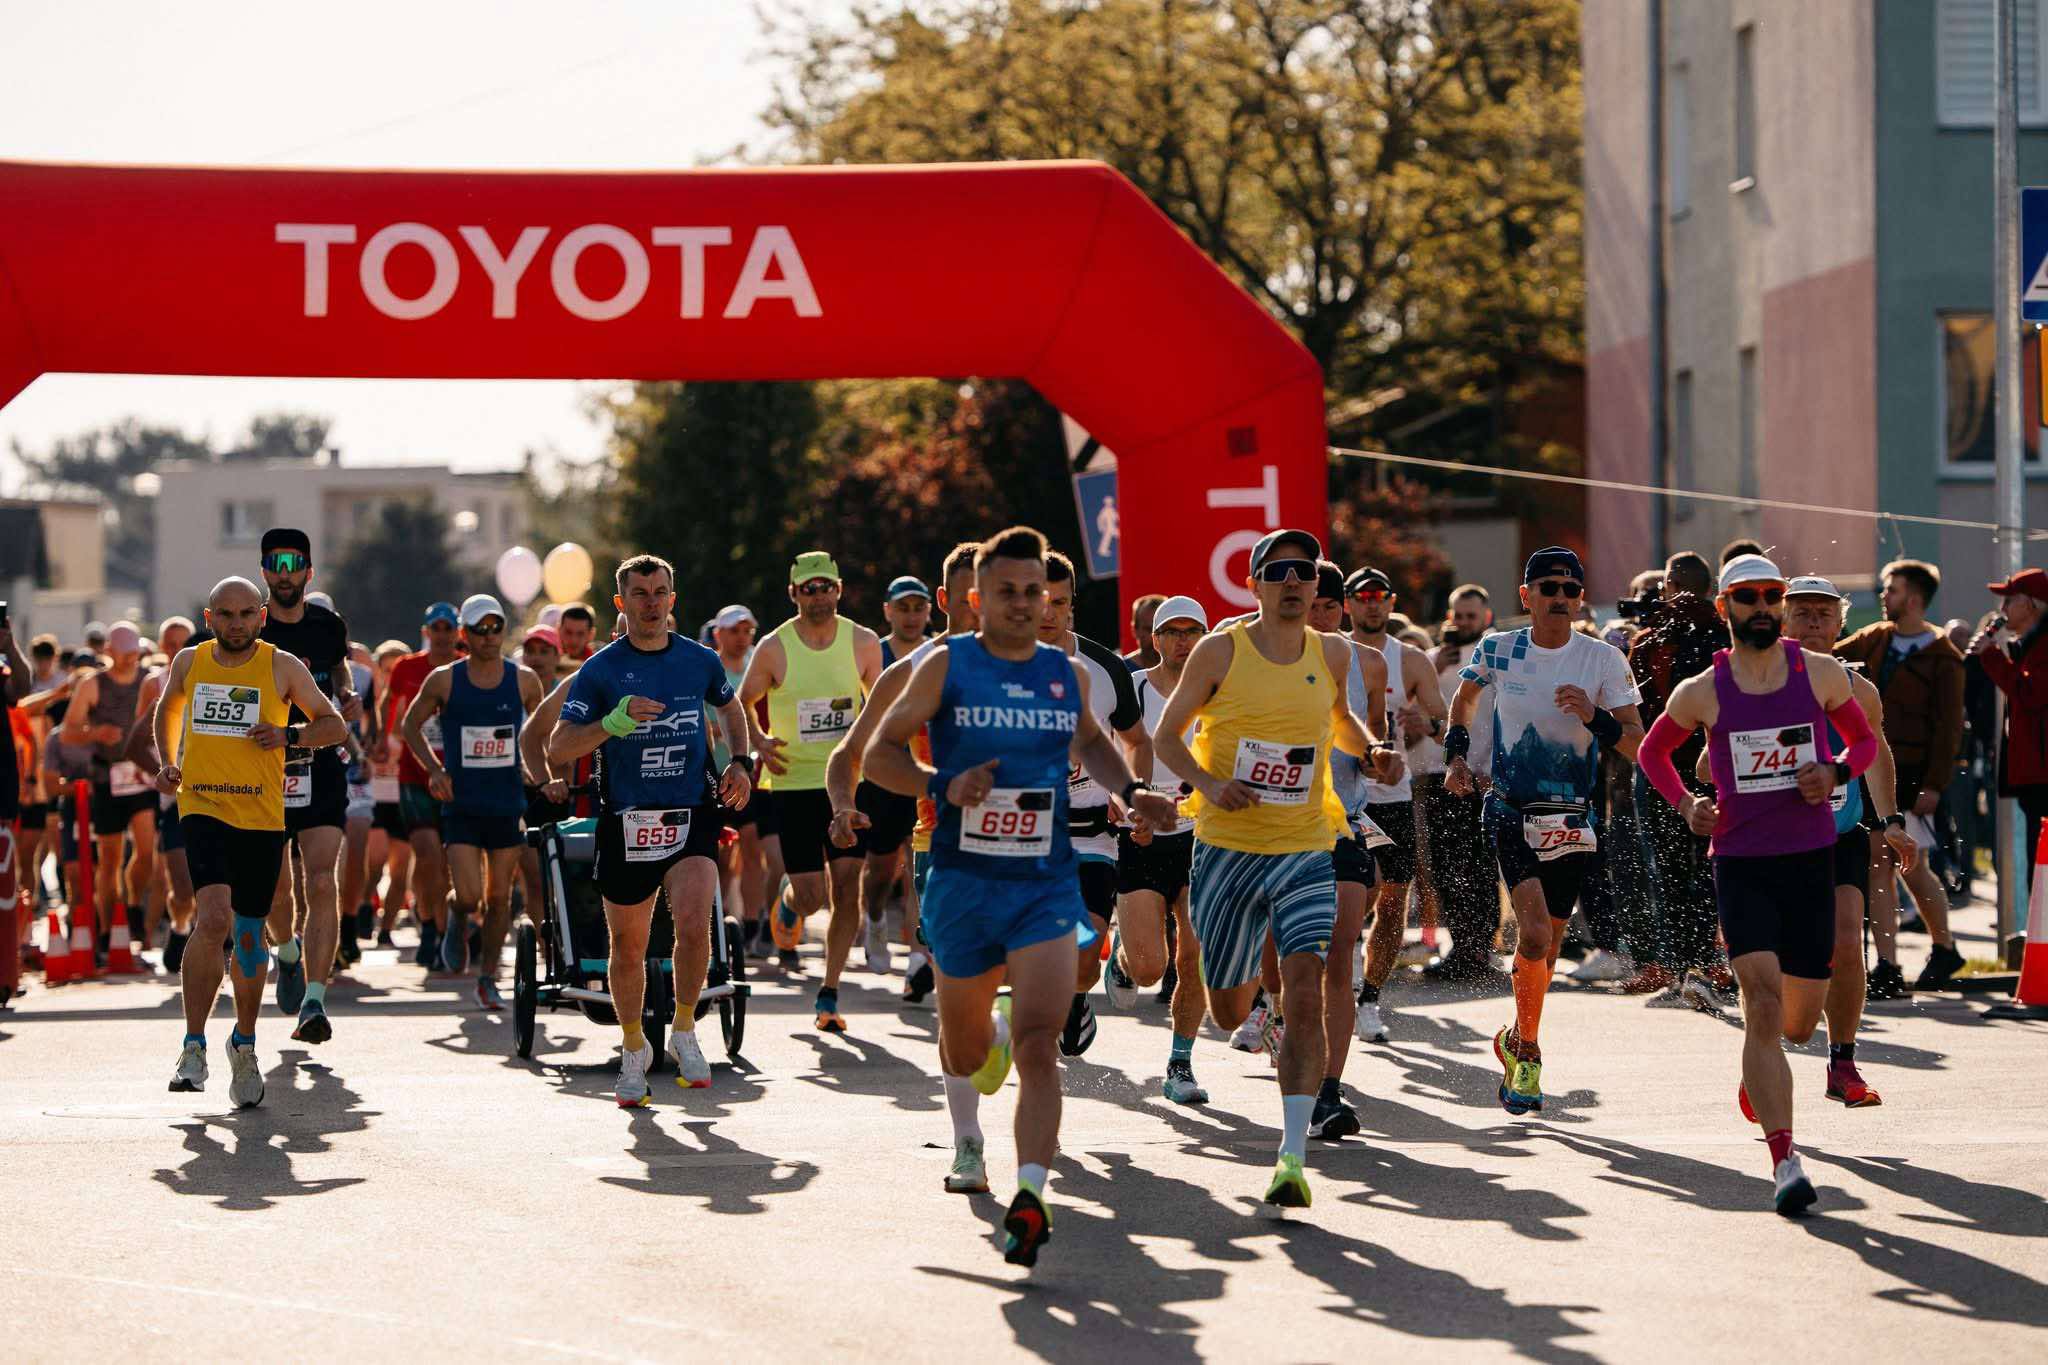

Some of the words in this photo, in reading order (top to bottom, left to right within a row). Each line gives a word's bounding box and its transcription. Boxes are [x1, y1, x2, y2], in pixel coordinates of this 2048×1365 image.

[275, 221, 823, 321] TOYOTA
[203, 701, 246, 721] 553
[810, 711, 845, 729] 548
[954, 706, 1079, 732] RUNNERS
[1751, 747, 1798, 773] 744
[1250, 762, 1302, 787] 669
[981, 811, 1038, 835] 699
[636, 827, 678, 846] 659
